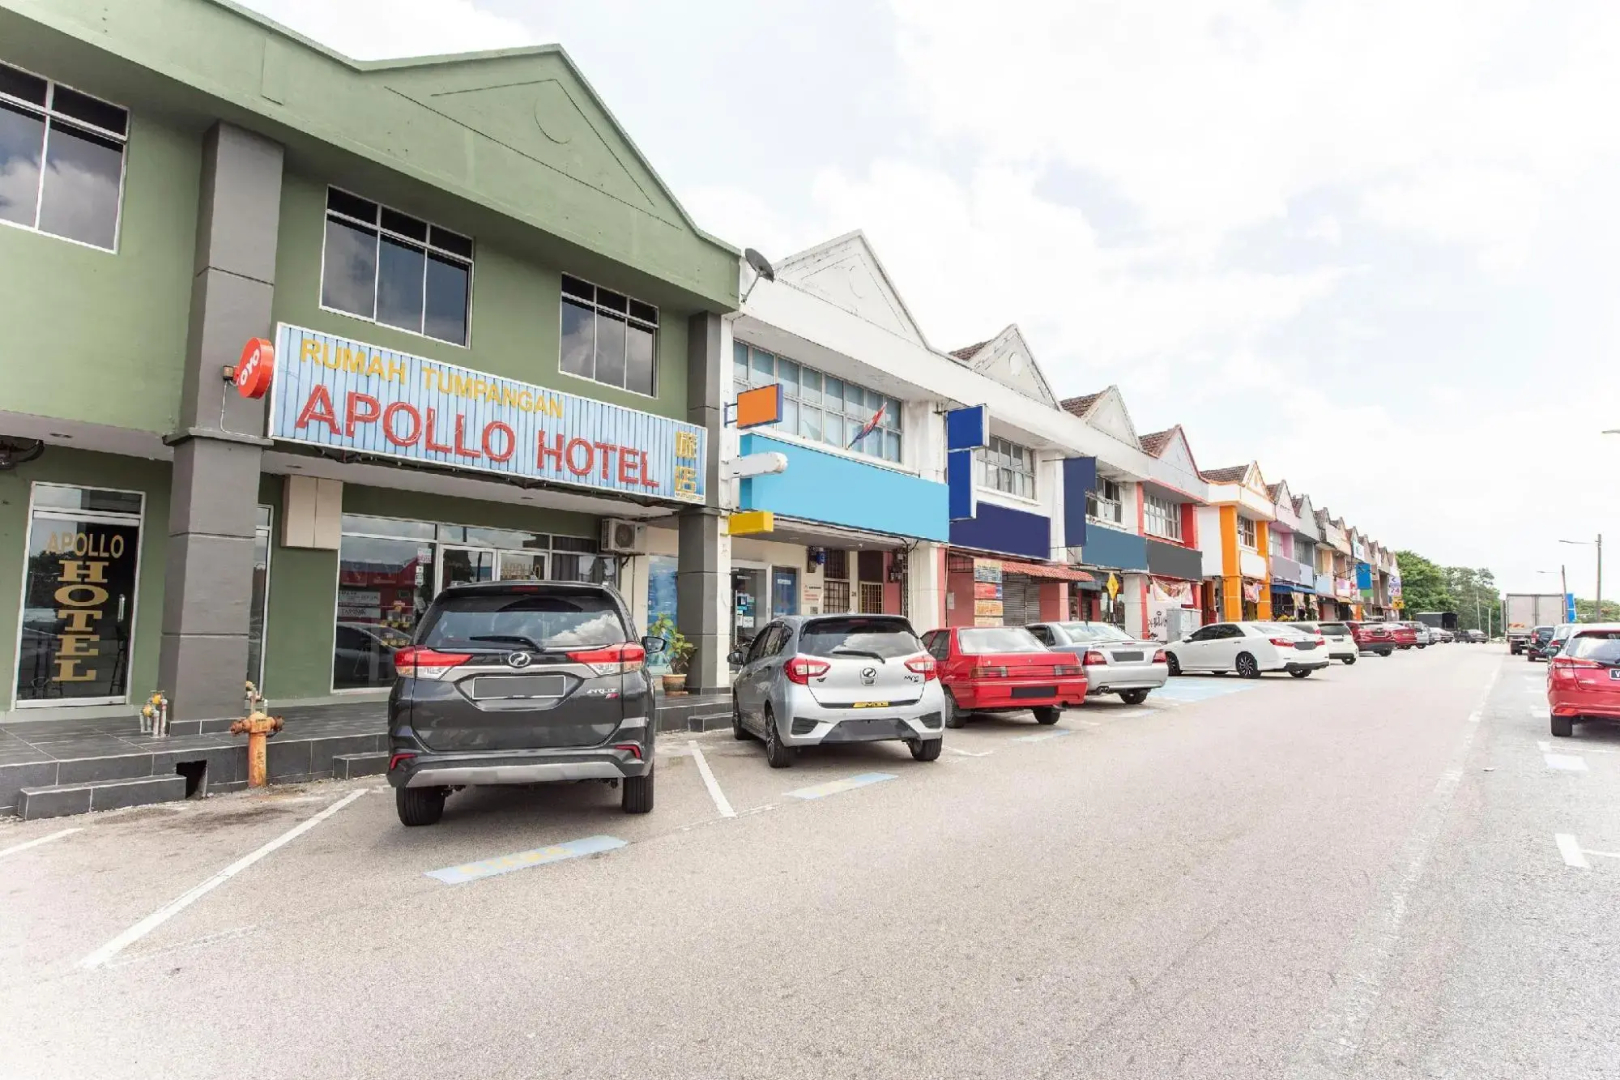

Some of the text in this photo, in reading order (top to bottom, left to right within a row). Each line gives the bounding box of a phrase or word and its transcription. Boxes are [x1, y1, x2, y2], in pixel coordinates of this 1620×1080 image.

[300, 338, 563, 419] RUMAH TUMPANGAN
[295, 384, 660, 488] APOLLO HOTEL
[46, 532, 124, 559] APOLLO
[52, 560, 110, 682] HOTEL
